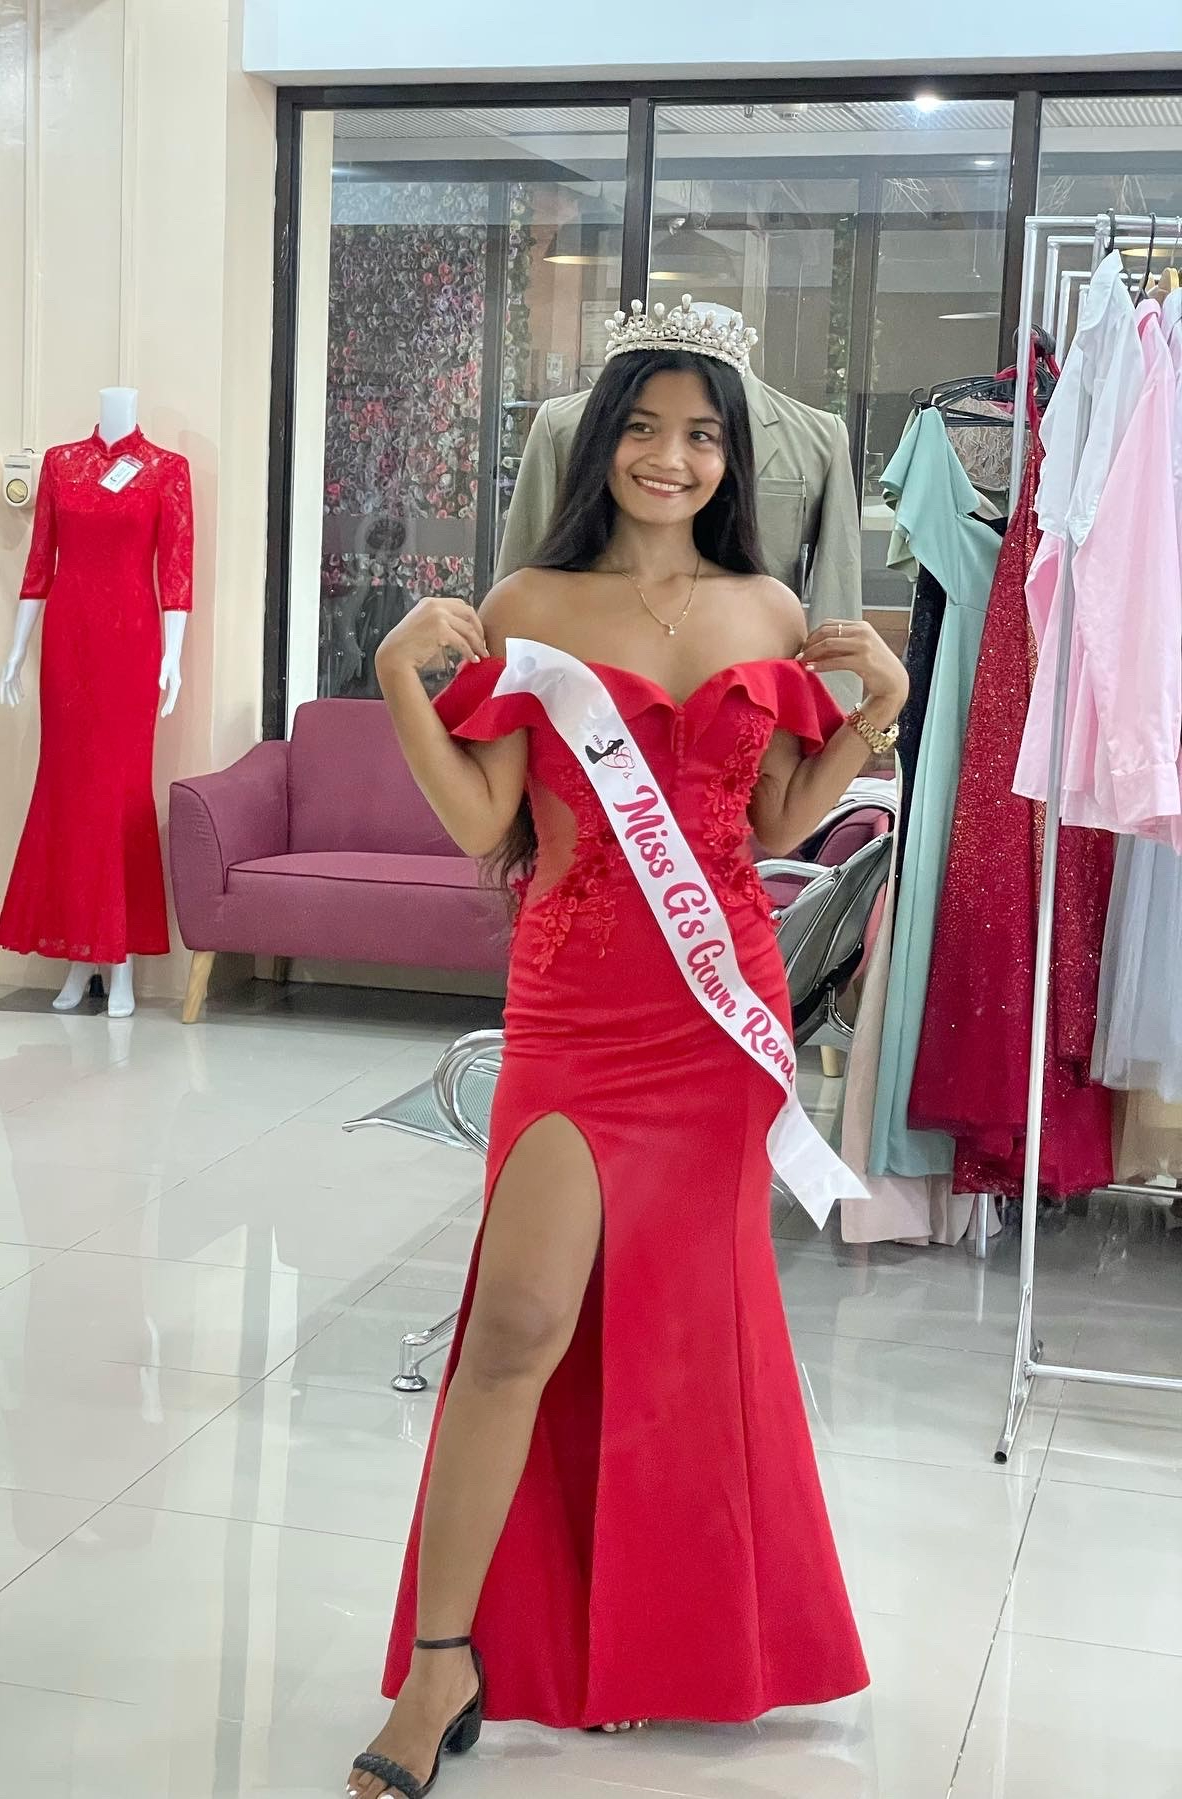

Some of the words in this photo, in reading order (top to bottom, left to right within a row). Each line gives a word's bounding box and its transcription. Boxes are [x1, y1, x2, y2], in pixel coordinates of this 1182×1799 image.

[613, 784, 675, 879] Miss
[662, 881, 711, 939] G's
[686, 939, 736, 1018] Gown
